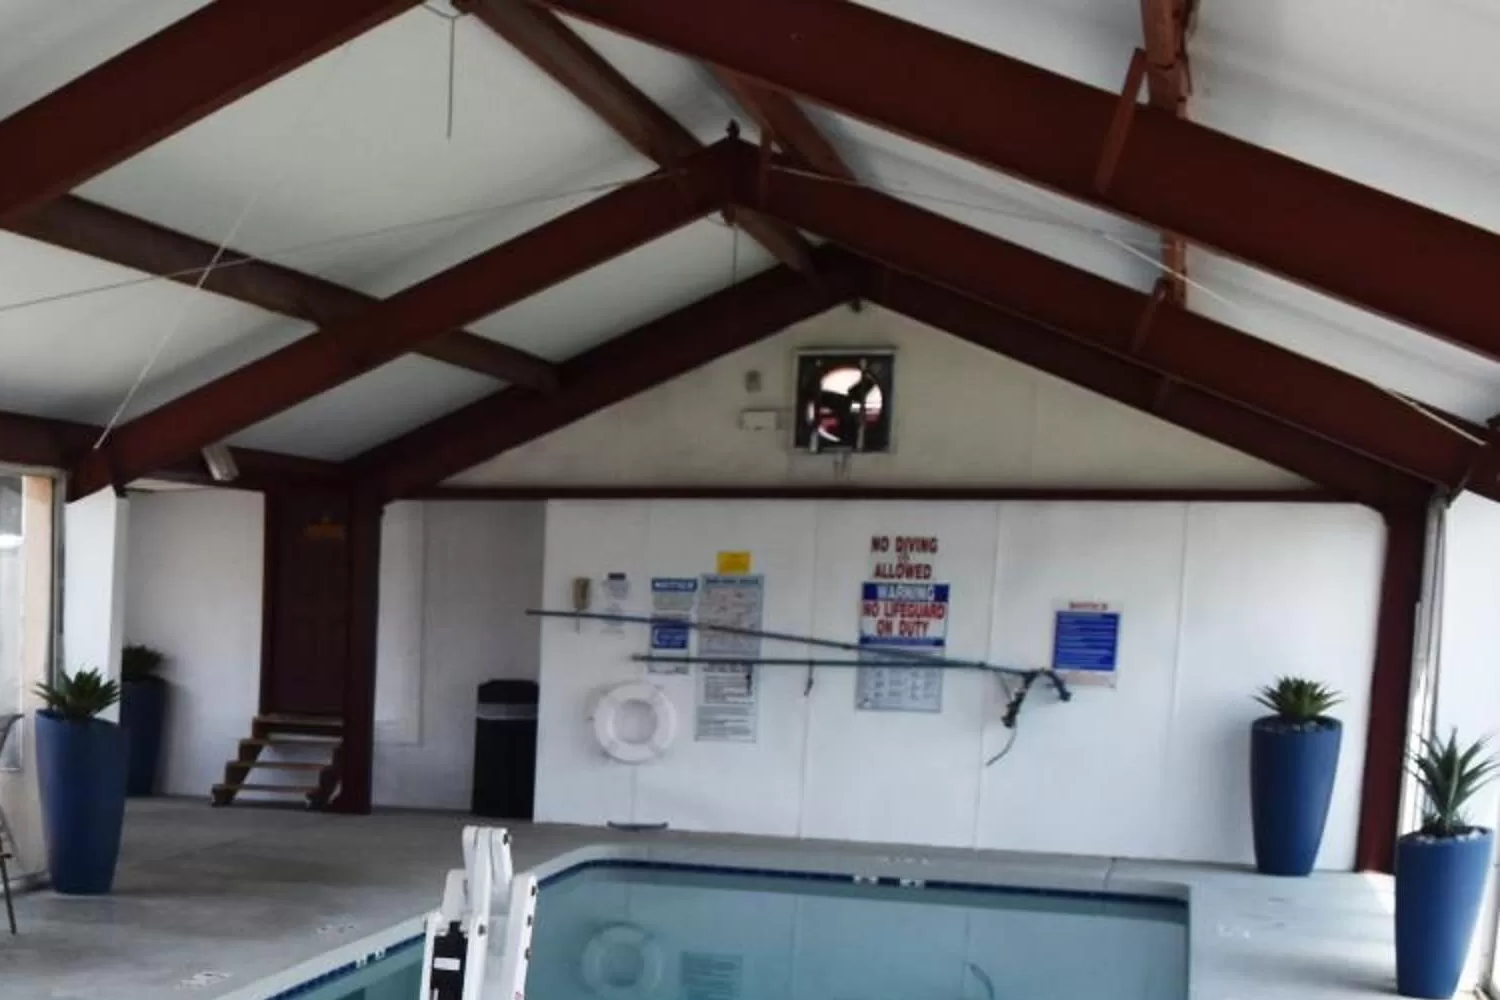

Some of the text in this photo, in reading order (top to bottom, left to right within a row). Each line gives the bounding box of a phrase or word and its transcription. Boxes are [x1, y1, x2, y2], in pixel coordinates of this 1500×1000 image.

[871, 536, 939, 553] NO DIVING
[874, 563, 932, 579] ALLOWED
[863, 602, 945, 619] NO LIFEGUARD
[876, 620, 931, 637] ON DUTY
